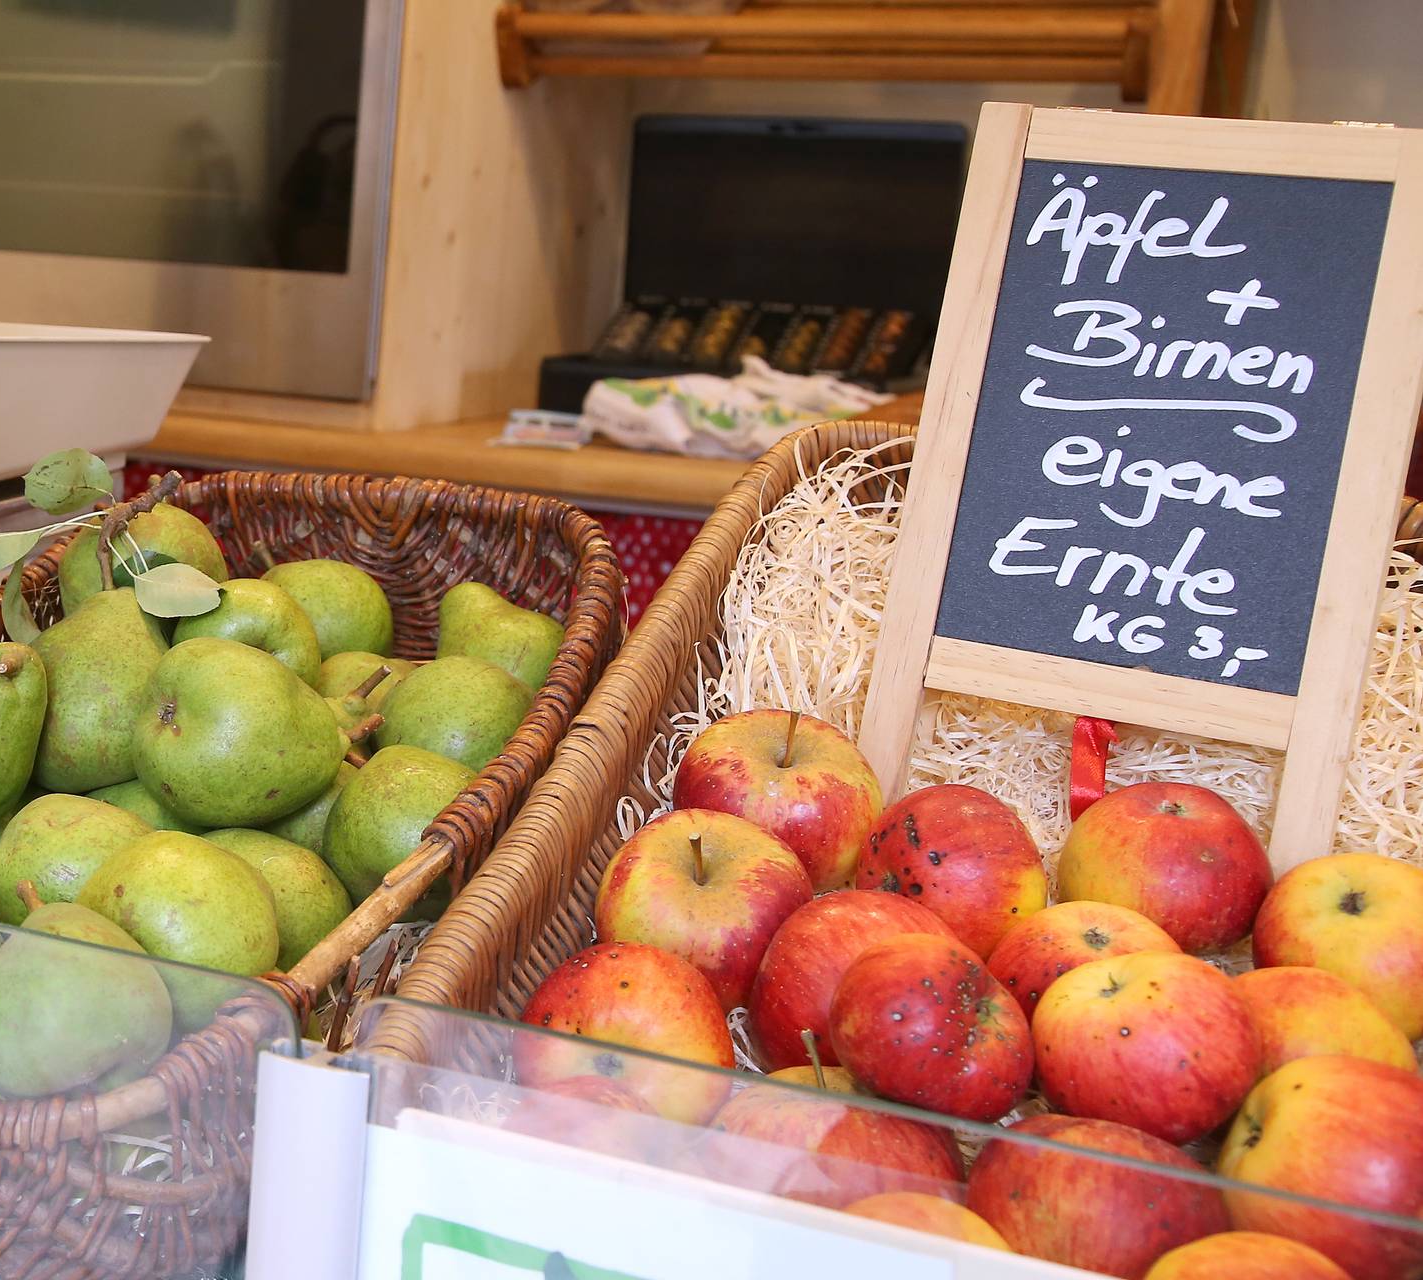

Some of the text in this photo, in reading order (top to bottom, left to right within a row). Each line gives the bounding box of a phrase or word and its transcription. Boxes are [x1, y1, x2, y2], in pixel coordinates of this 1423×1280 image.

[1026, 173, 1247, 286] Äpfel
[1026, 299, 1315, 394] Birnen
[1206, 278, 1280, 325] +
[1041, 425, 1285, 528] eigene
[988, 516, 1239, 616] Ernte
[1072, 603, 1165, 653] KG
